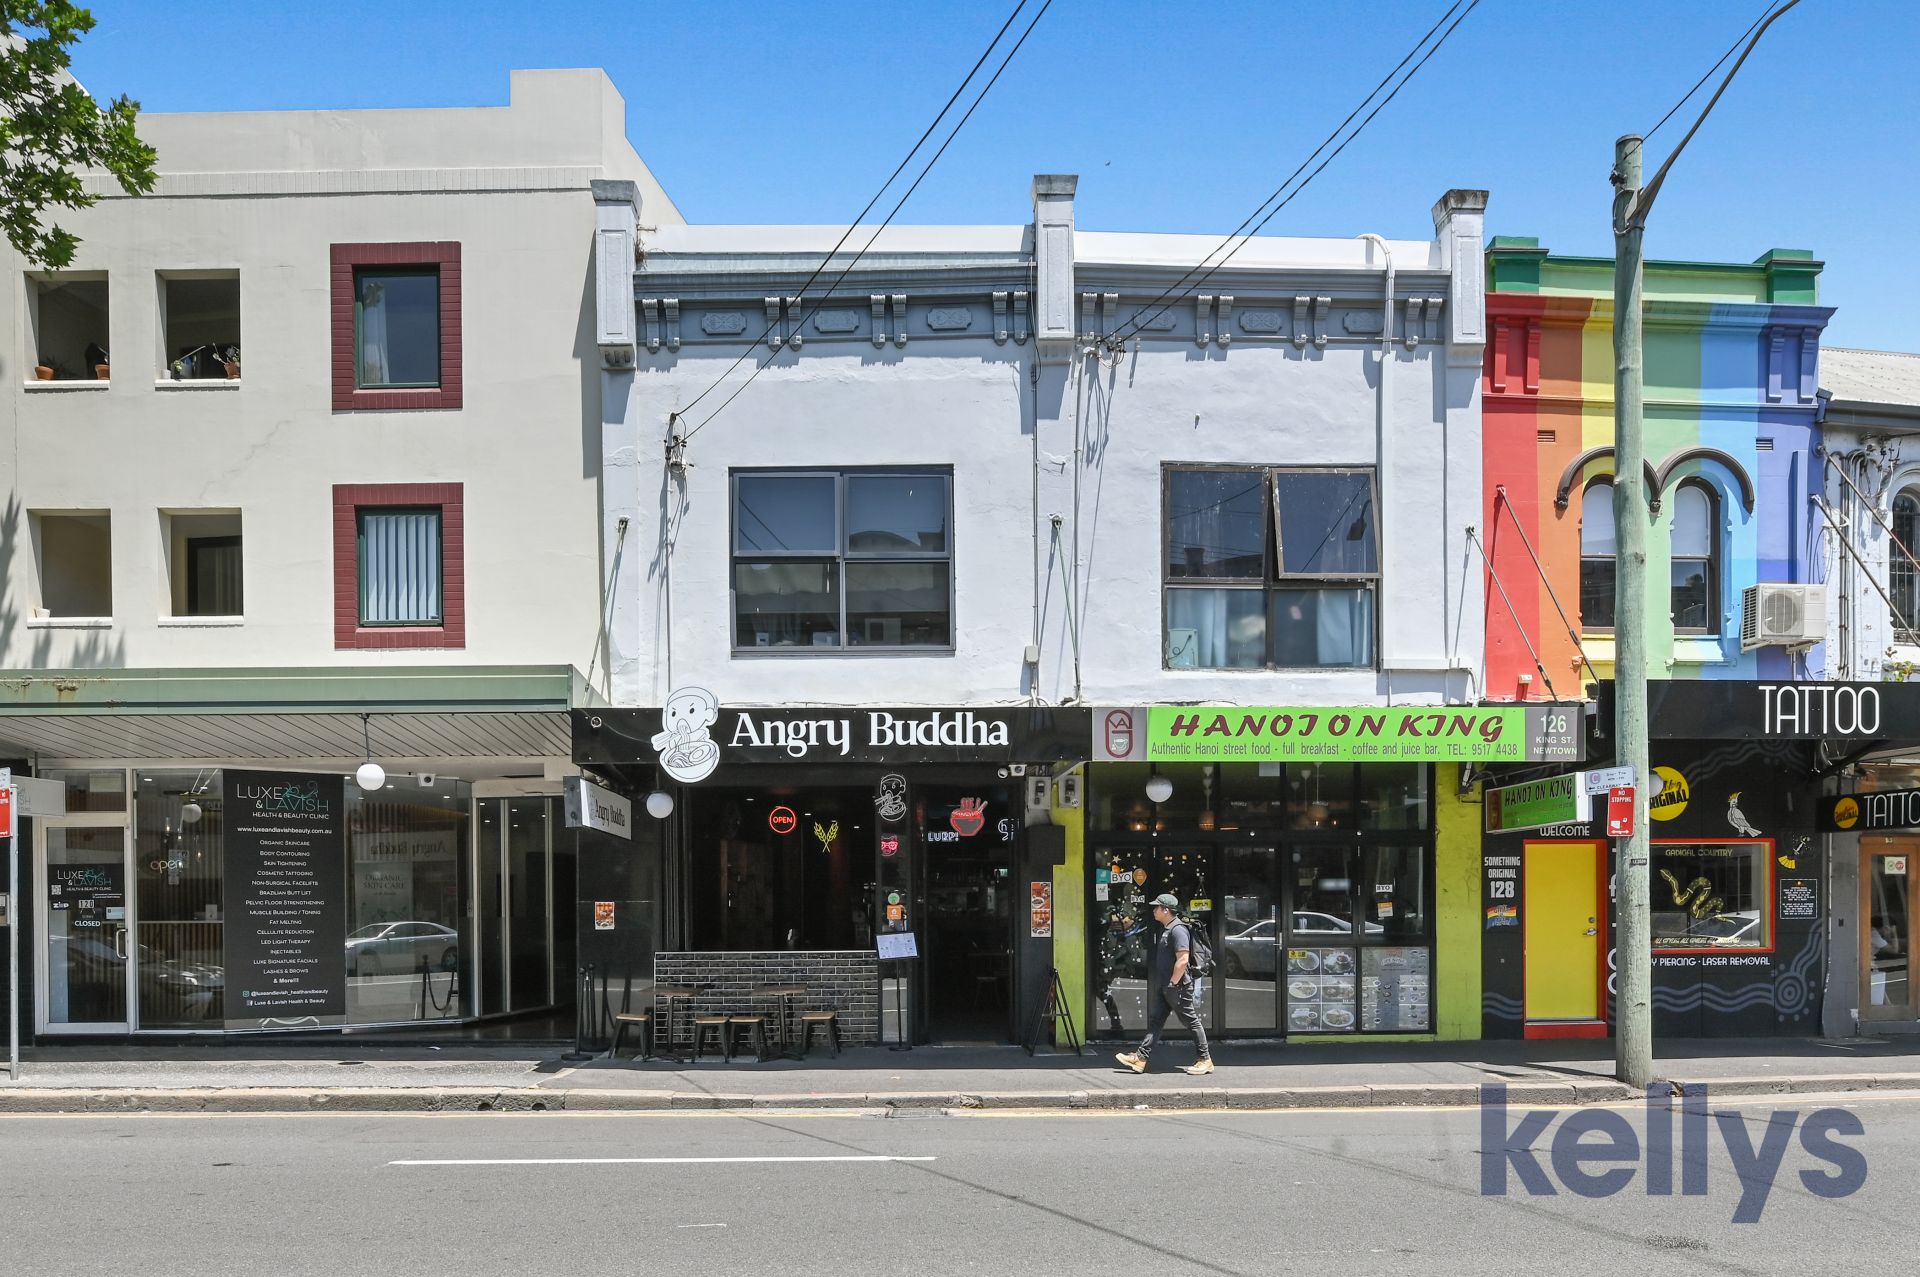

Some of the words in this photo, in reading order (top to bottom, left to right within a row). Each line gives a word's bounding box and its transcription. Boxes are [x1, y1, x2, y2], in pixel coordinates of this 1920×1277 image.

[1758, 685, 1880, 735] TATTOO
[1327, 714, 1387, 737] ON
[1397, 714, 1504, 743] KING
[1540, 715, 1567, 733] 126
[728, 712, 849, 758] Angry
[868, 711, 1010, 747] Buddha
[1535, 736, 1558, 744] KING
[1560, 736, 1575, 744] ST.
[1151, 741, 1191, 755] Authentic
[1195, 742, 1219, 755] Hanoi
[1223, 743, 1247, 755] street
[1251, 742, 1271, 755] food
[1282, 742, 1295, 755] full
[1301, 742, 1339, 755] breakfast
[1352, 742, 1378, 755] coffee
[1382, 742, 1397, 755] and
[1401, 742, 1420, 757] juice
[1424, 742, 1440, 755] bar.
[1447, 743, 1467, 755] TEL:
[1471, 743, 1491, 755] 9517
[1495, 743, 1518, 755] 4438
[1533, 746, 1578, 755] NEWTOWN
[236, 783, 283, 800] LUXE
[1535, 783, 1547, 801] ON
[1550, 779, 1573, 800] KING
[255, 799, 264, 809] &
[265, 797, 329, 812] LAVISH
[1648, 788, 1689, 811] RIGINAL
[595, 799, 610, 827] Angry
[610, 804, 626, 827] Buddha
[772, 816, 793, 824] OPEN
[237, 826, 333, 835] www.luxeandlavishbeauty.com.au
[1540, 825, 1591, 837] WELCOME
[1665, 849, 1696, 857] GADIGAL
[1698, 848, 1733, 857] COUNTRY
[150, 859, 184, 875] open
[1484, 856, 1521, 867] SOMETHING
[57, 869, 84, 881] LUXE
[1111, 873, 1132, 882] BYO
[1488, 868, 1517, 879] ORIGINAL
[74, 877, 112, 887] LAVISH
[1490, 880, 1515, 899] 128
[79, 900, 95, 908] 120
[1659, 957, 1697, 967] PIERCING
[1702, 957, 1728, 966] LASER
[1730, 957, 1770, 966] REMOVAL
